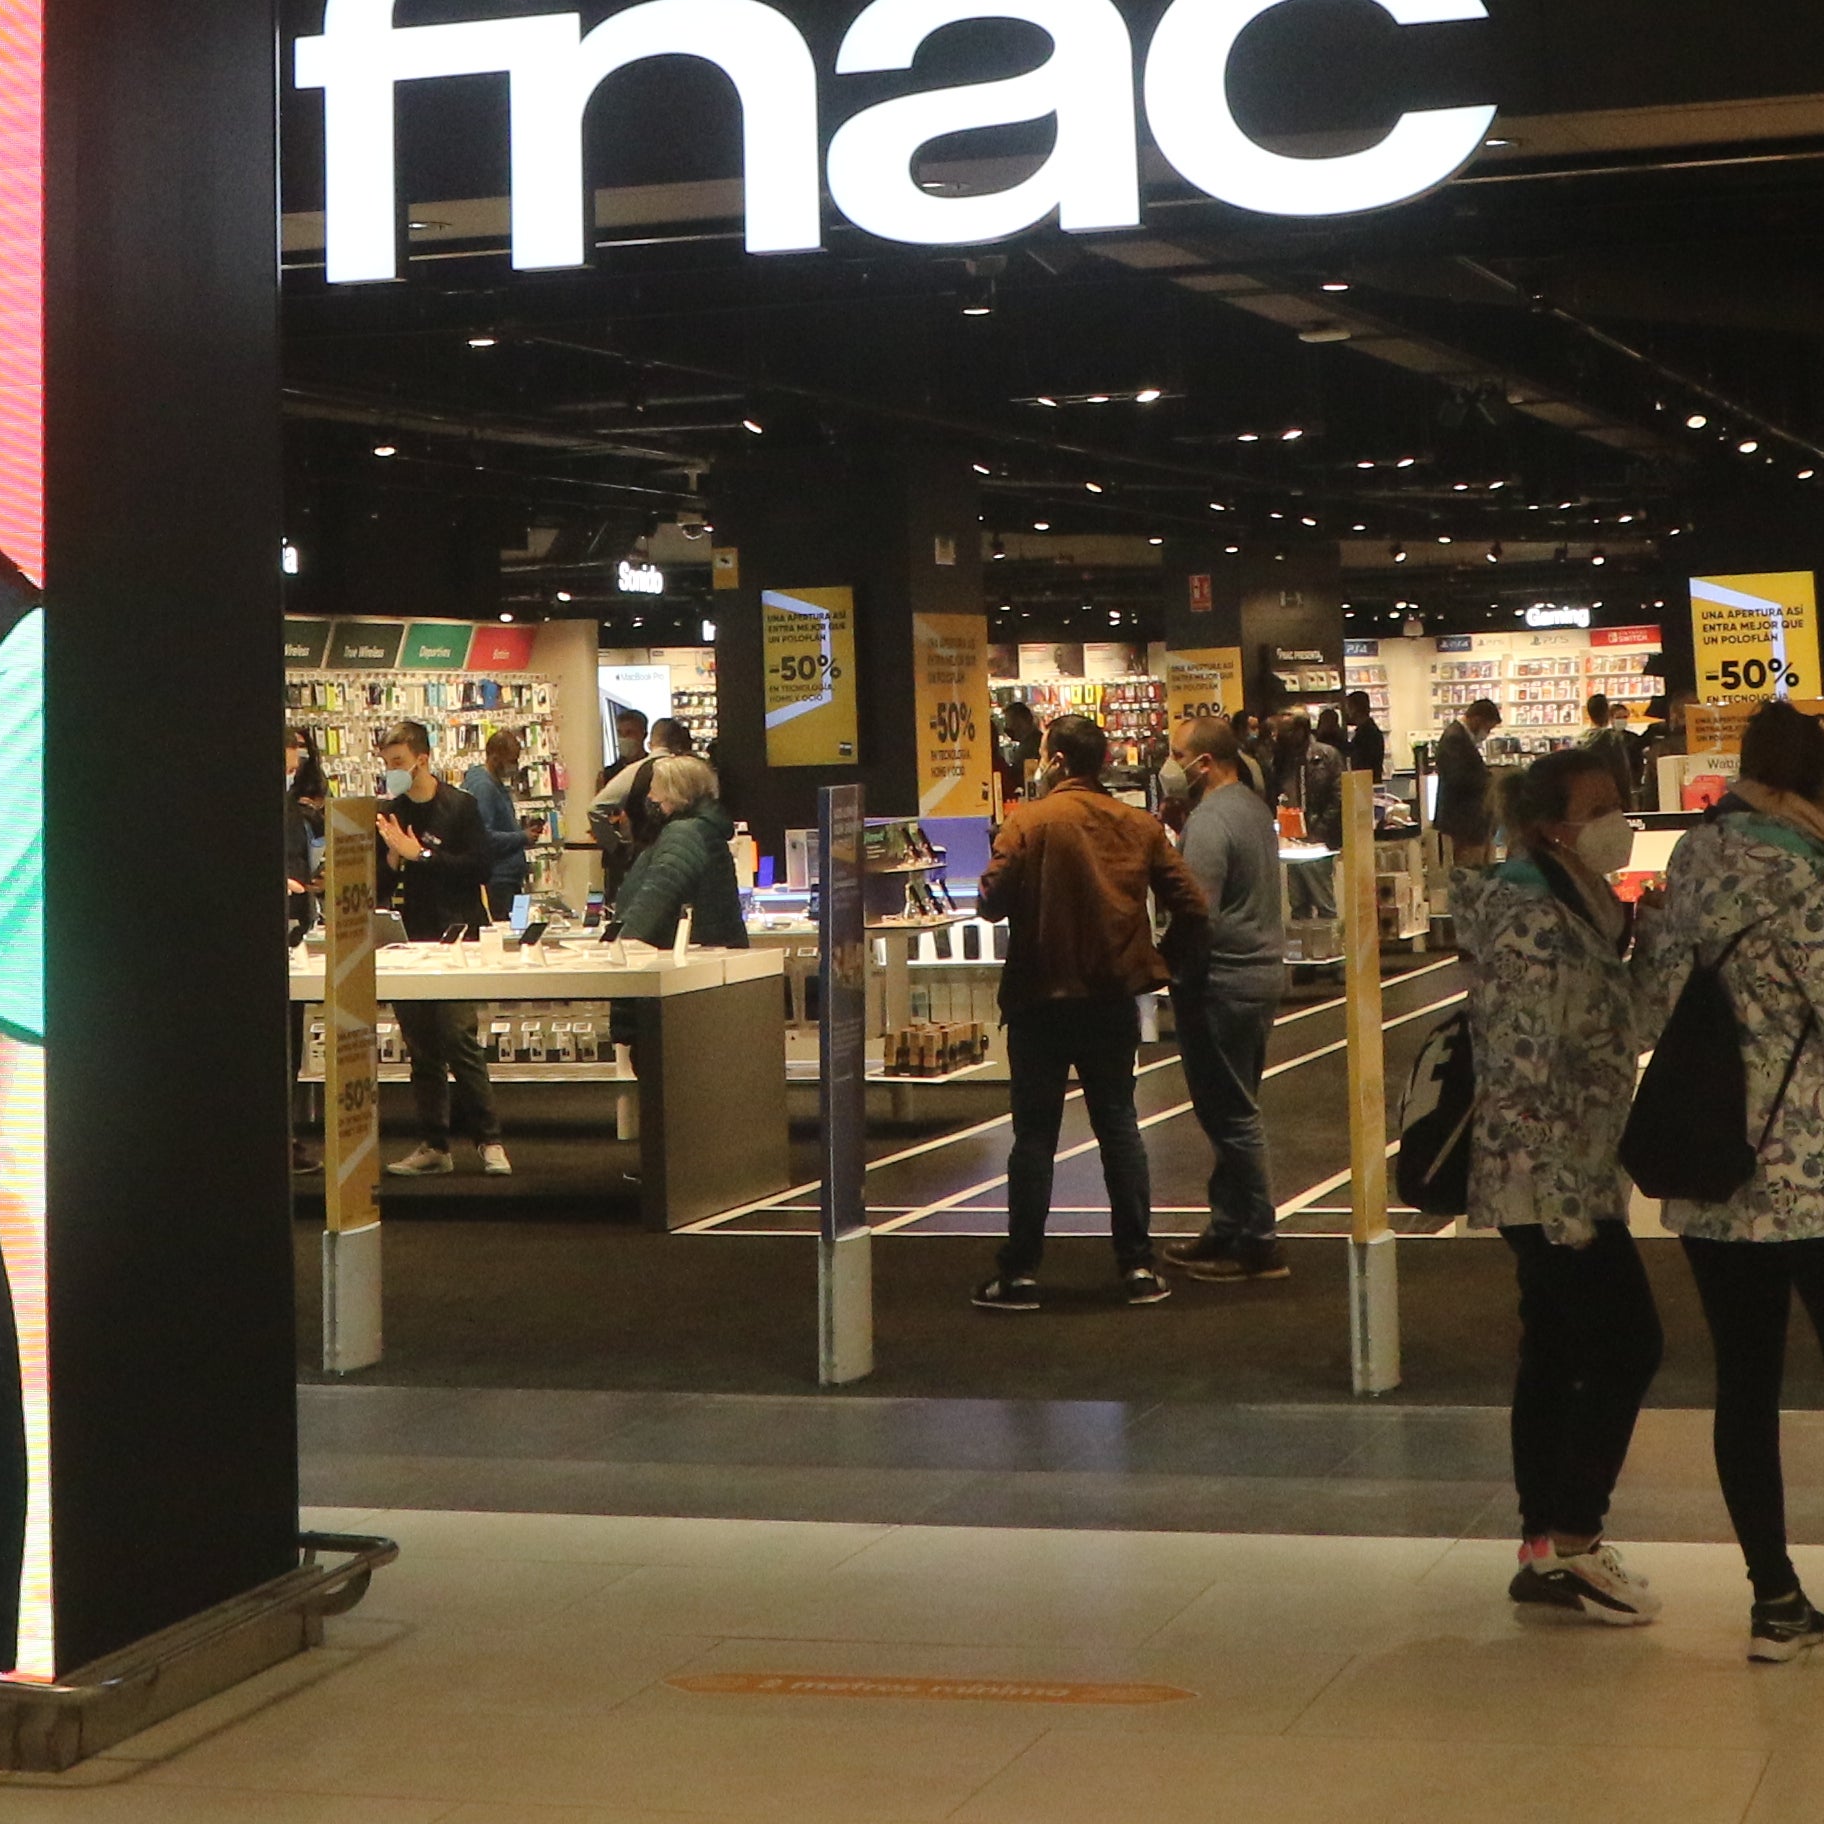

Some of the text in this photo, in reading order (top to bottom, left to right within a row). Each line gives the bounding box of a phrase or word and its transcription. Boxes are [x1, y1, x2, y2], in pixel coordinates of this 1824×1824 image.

[619, 561, 664, 594] Sonido
[1526, 607, 1590, 628] Gaming
[1702, 604, 1803, 620] UNA APERTURA ASÍ
[1703, 619, 1804, 632] ENTRA MEJOR QUE
[1703, 633, 1778, 645] UN POLOFLÁN
[769, 654, 842, 682] -50%
[1706, 658, 1799, 690] -50%
[1707, 696, 1719, 704] EN
[930, 702, 976, 743] -50%
